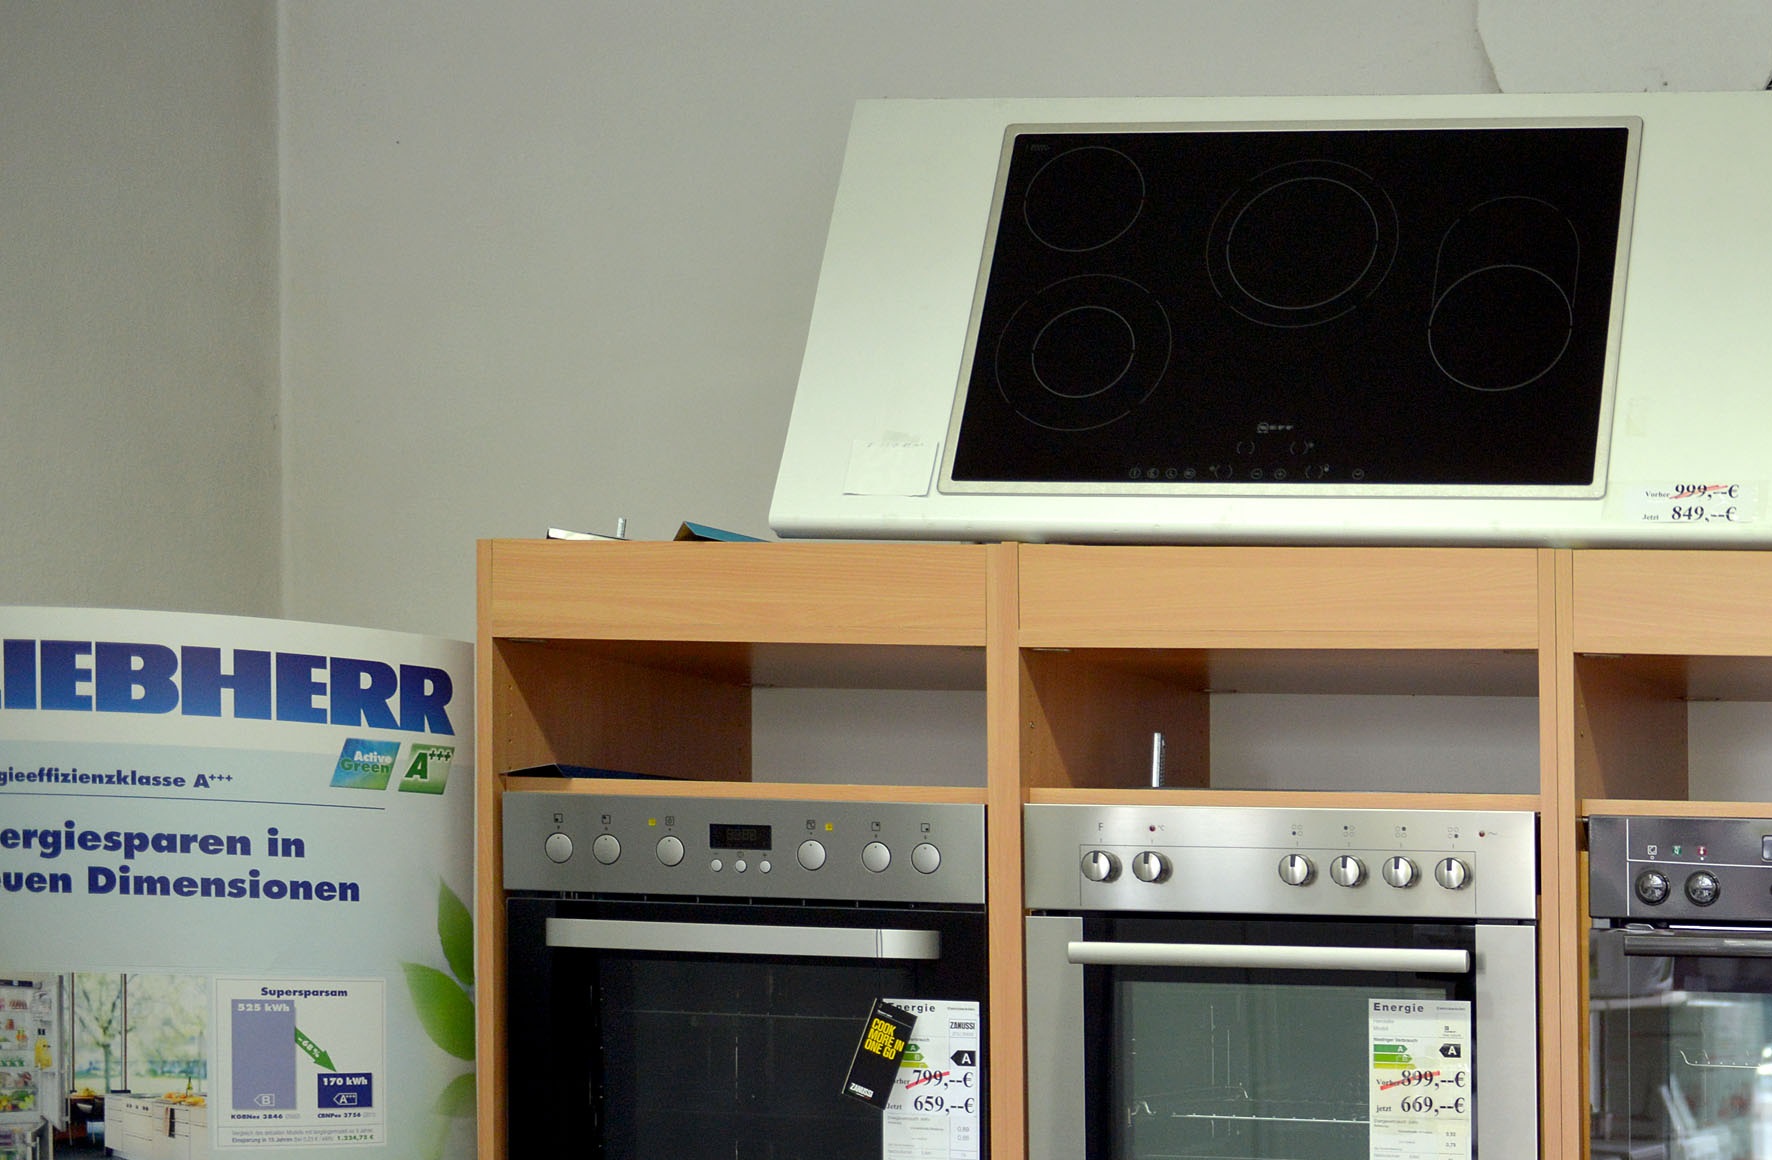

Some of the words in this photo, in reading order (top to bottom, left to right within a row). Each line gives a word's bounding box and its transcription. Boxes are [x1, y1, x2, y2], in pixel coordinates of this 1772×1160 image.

[1645, 490, 1670, 498] Vorher
[1674, 484, 1739, 500] 999,--€
[1642, 513, 1660, 521] Jetzt
[1671, 505, 1737, 522] 849,--€
[0, 639, 455, 736] IEBHERR
[340, 758, 390, 773] Green
[353, 750, 393, 764] Active
[267, 827, 305, 858] in
[0, 871, 72, 893] uen
[87, 865, 360, 902] Dimensionen
[261, 987, 348, 998] Supersparsam
[237, 1003, 261, 1012] 525
[265, 1003, 290, 1012] kWh
[1373, 1002, 1424, 1014] Energie
[872, 1018, 896, 1035] COOK
[950, 1022, 976, 1030] ZANUSSI
[868, 1028, 894, 1048] MORE
[894, 1040, 905, 1052] IN
[864, 1038, 884, 1055] ONE
[882, 1046, 896, 1060] GO
[1448, 1046, 1456, 1056] A
[962, 1052, 972, 1064] A
[323, 1077, 343, 1086] 170
[346, 1076, 368, 1085] kWh
[912, 1069, 974, 1090] 799,--€
[1400, 1070, 1466, 1089] 899,--€
[914, 1095, 975, 1116] 659,--€
[1376, 1104, 1392, 1112] jetzt
[1400, 1096, 1466, 1116] 669,--€
